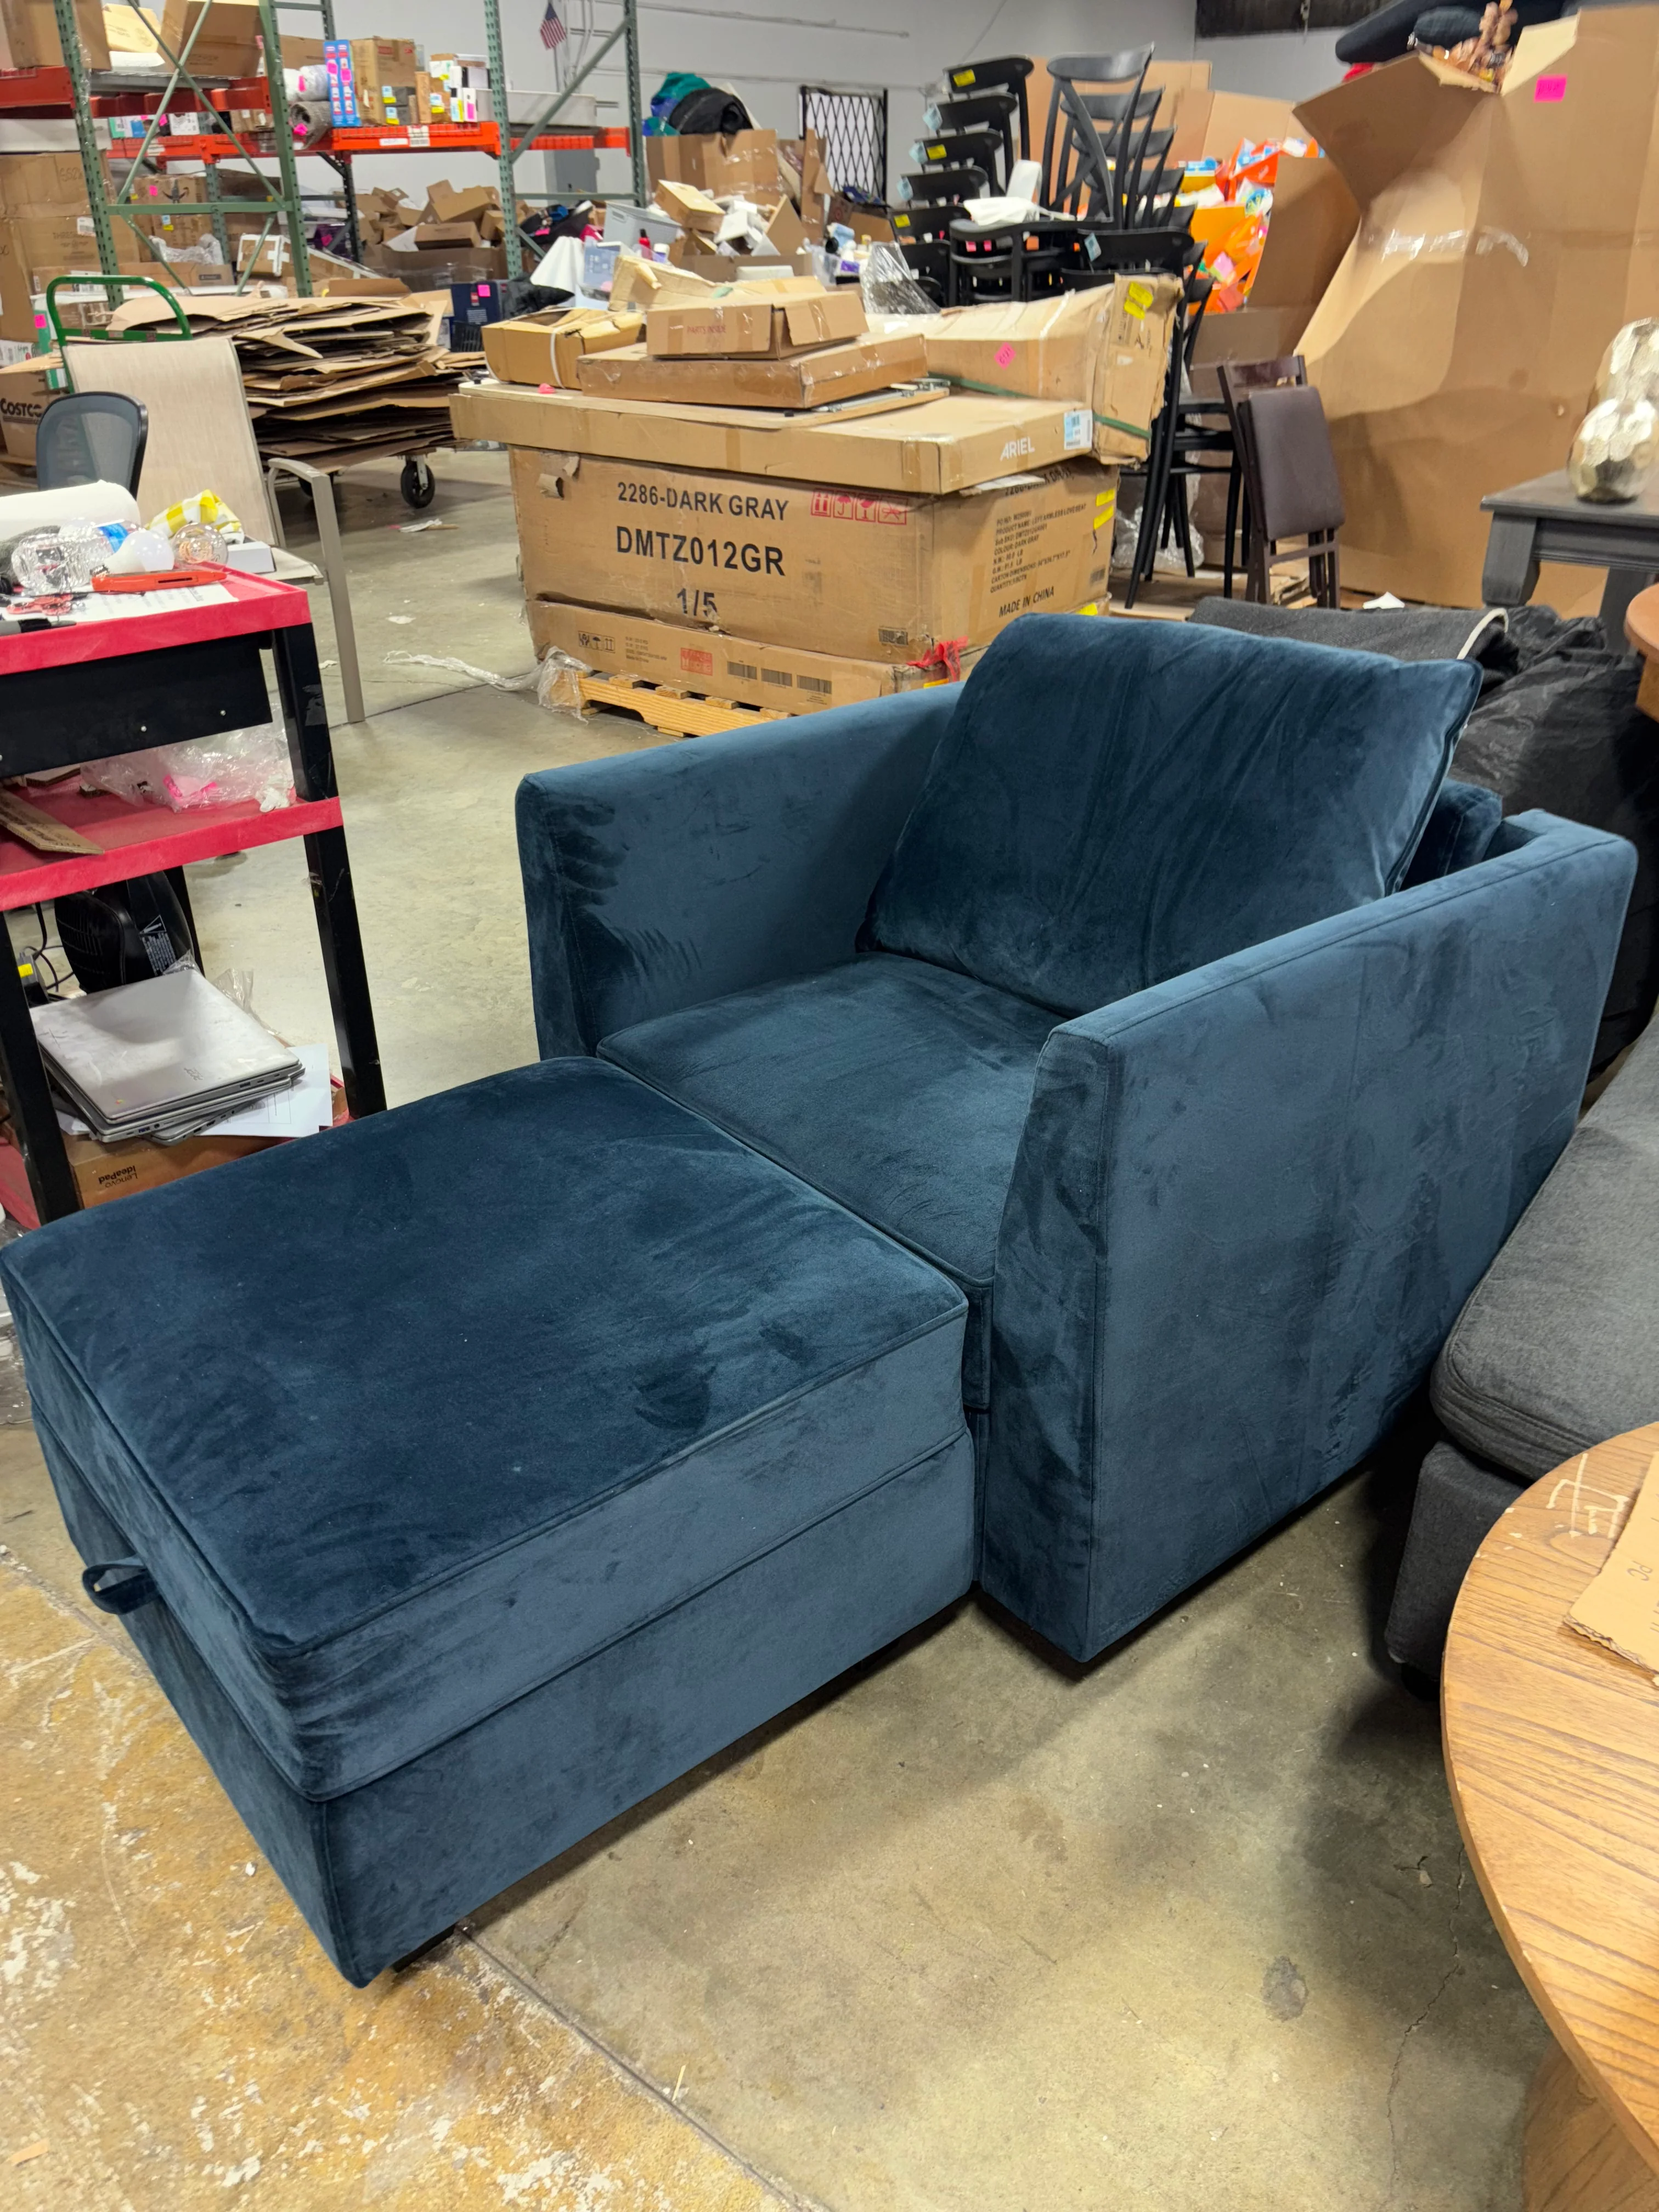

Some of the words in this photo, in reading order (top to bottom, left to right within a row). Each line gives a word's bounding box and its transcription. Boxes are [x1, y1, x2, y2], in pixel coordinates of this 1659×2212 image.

[1000, 436, 1035, 462] ARIEL
[618, 482, 723, 514] 2286-DARK
[729, 495, 789, 521] GRAY
[617, 525, 786, 577] DMTZ012GR
[677, 588, 718, 617] 1/5
[999, 599, 1020, 618] MADE
[1023, 596, 1030, 608] IN
[1033, 586, 1054, 602] CHINA
[98, 1165, 136, 1185] IdeaPad
[105, 1172, 138, 1188] Lenovo
